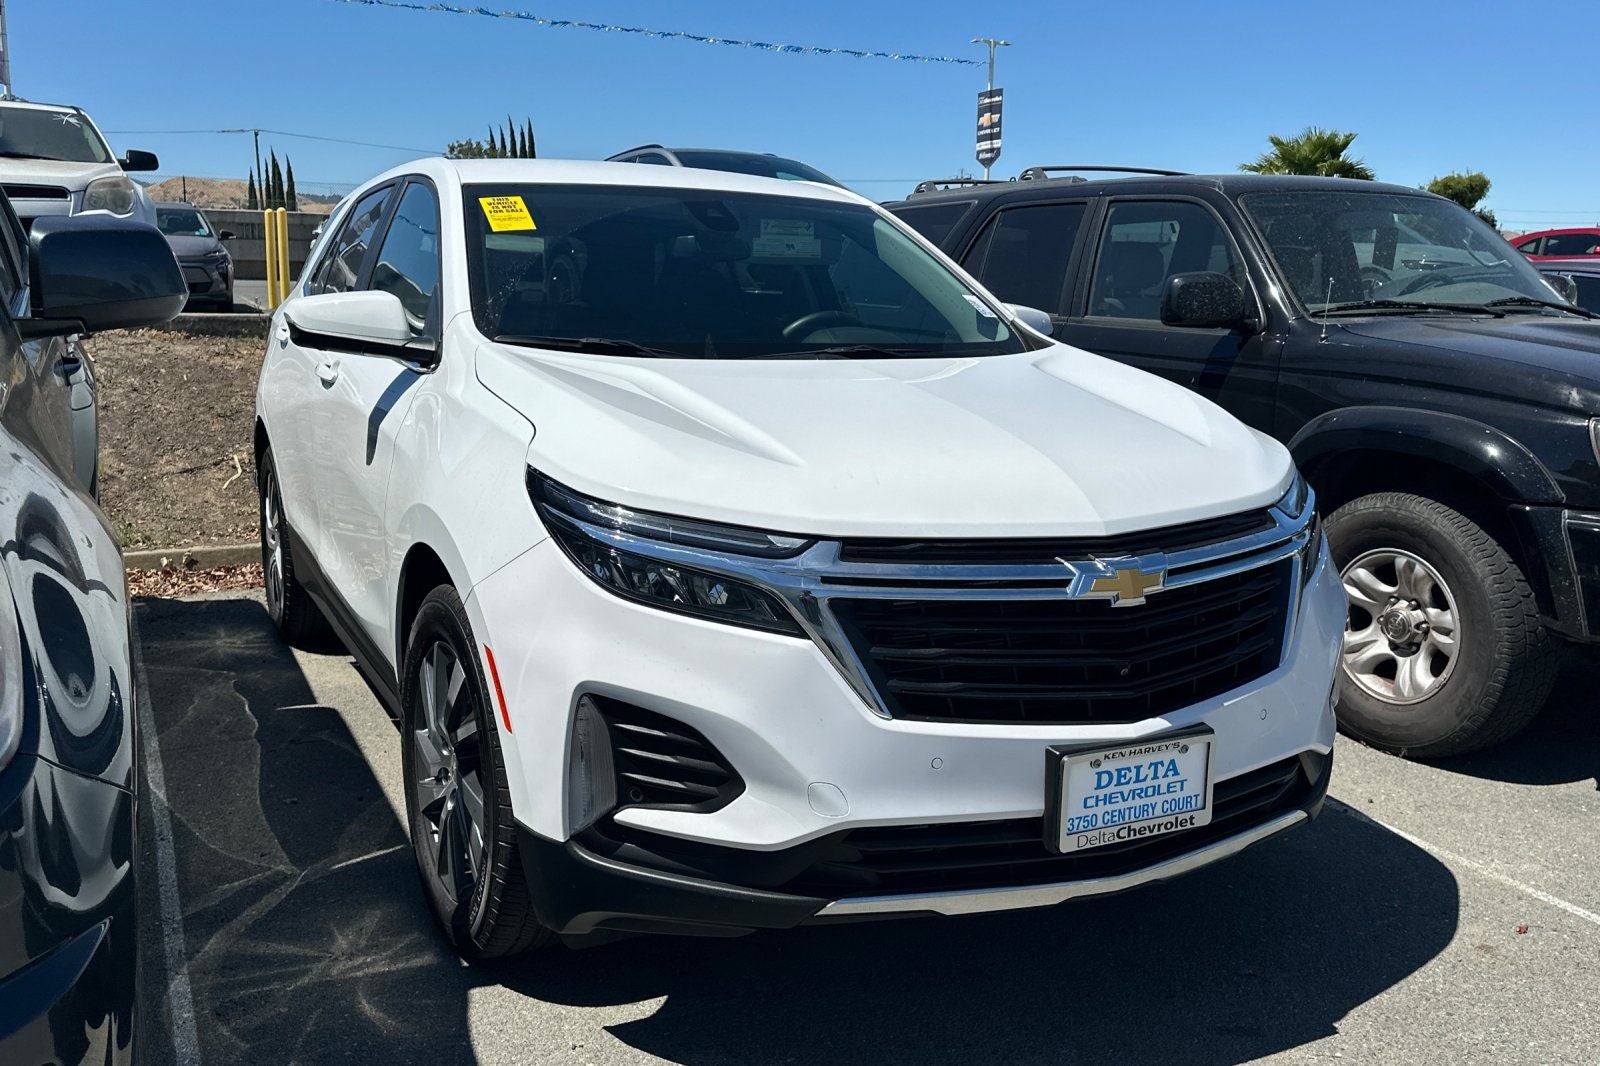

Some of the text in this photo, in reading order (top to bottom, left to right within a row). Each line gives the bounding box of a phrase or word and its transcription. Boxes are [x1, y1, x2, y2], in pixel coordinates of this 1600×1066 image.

[1104, 742, 1181, 760] KEN HARVEY'S
[1094, 758, 1180, 790] DELTA
[1083, 779, 1188, 809] CHEVROLET
[1067, 793, 1200, 832] 3750 CENTURY COURT
[1077, 814, 1196, 848] DeltaChevrolet
